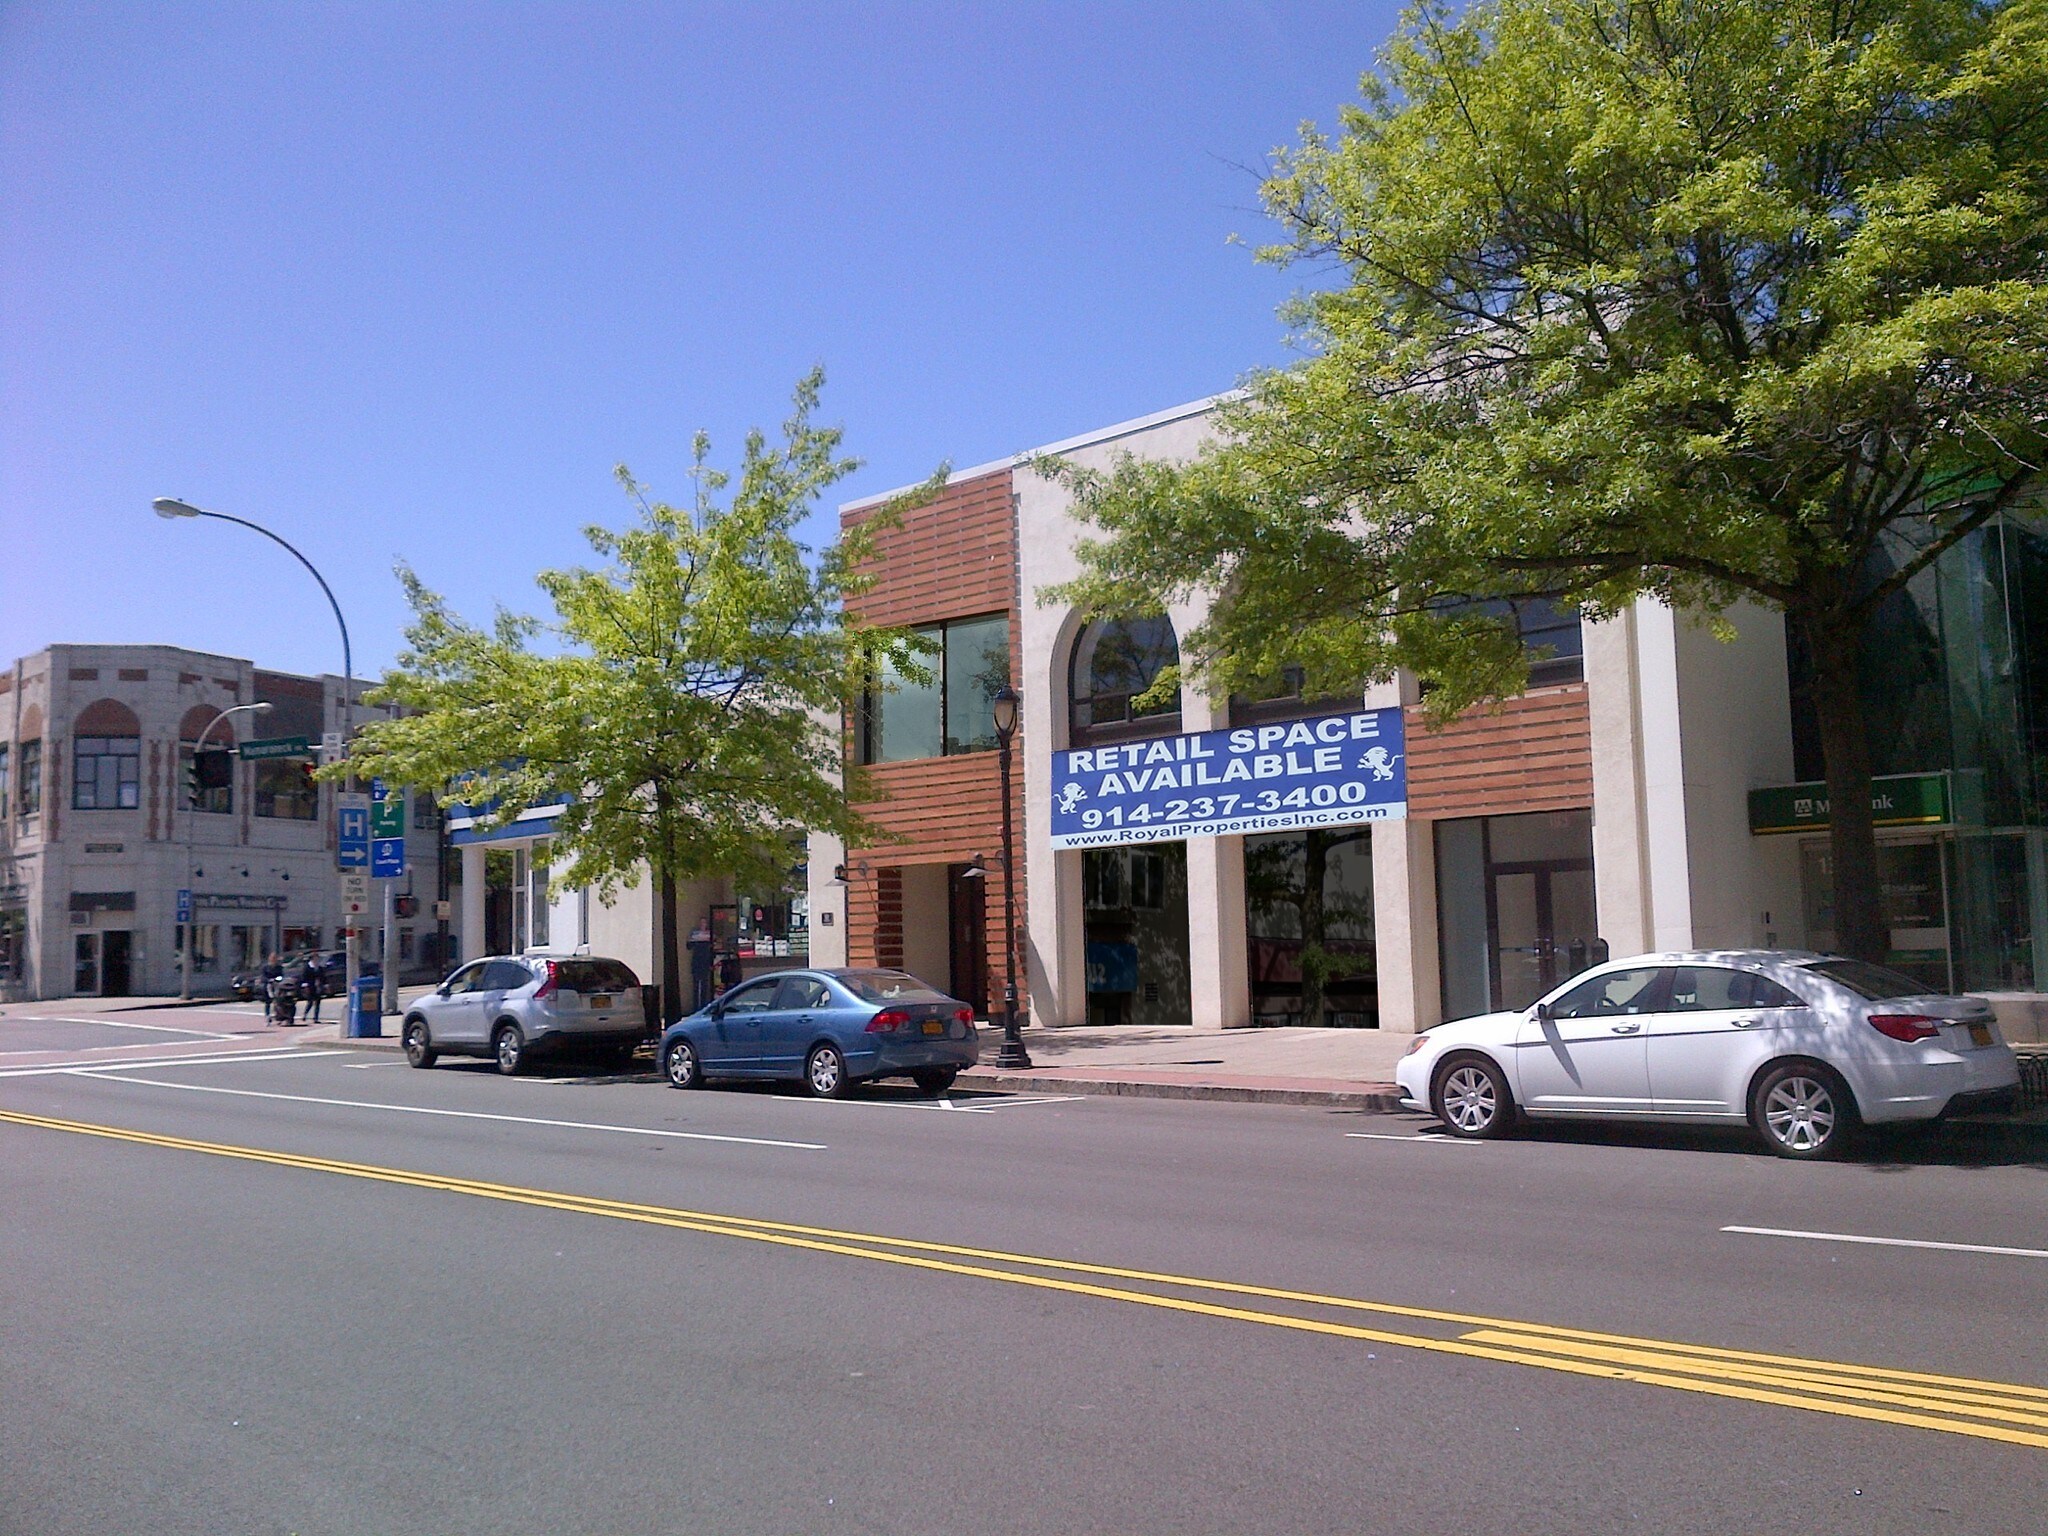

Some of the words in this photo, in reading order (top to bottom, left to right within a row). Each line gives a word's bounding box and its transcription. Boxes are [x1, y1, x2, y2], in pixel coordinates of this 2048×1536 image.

[1069, 736, 1214, 774] RETAIL
[1228, 713, 1379, 754] SPACE
[1098, 747, 1342, 797] AVAILABLE
[344, 813, 363, 837] H
[383, 804, 393, 818] P
[1081, 782, 1367, 829] 914-237-3400
[1066, 807, 1387, 846] www.RoyalPropertiesInc.com
[348, 878, 361, 886] NO
